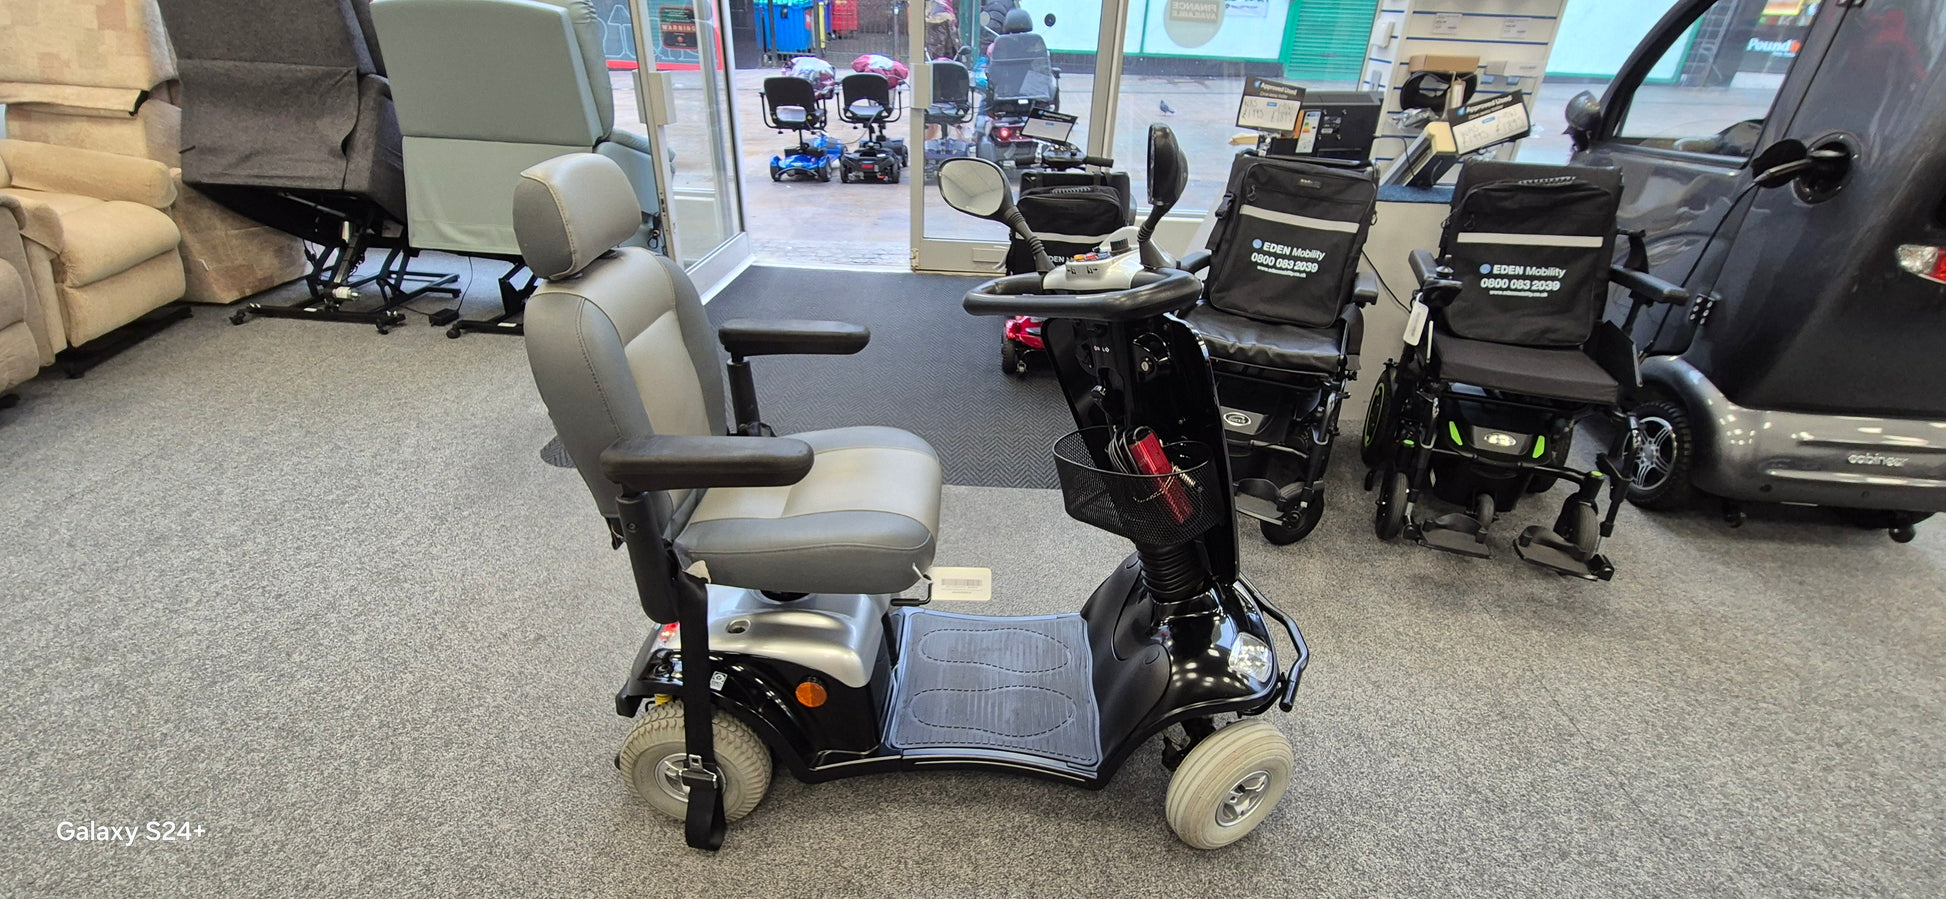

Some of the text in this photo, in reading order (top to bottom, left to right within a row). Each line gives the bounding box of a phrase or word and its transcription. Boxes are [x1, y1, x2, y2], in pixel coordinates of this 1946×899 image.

[1263, 241, 1325, 261] EDEN Mobility
[1048, 255, 1065, 263] DEN
[1250, 252, 1318, 273] 0800 083 2039
[1492, 264, 1566, 279] EDEN Mobility
[1480, 277, 1561, 291] 0800 083 2039
